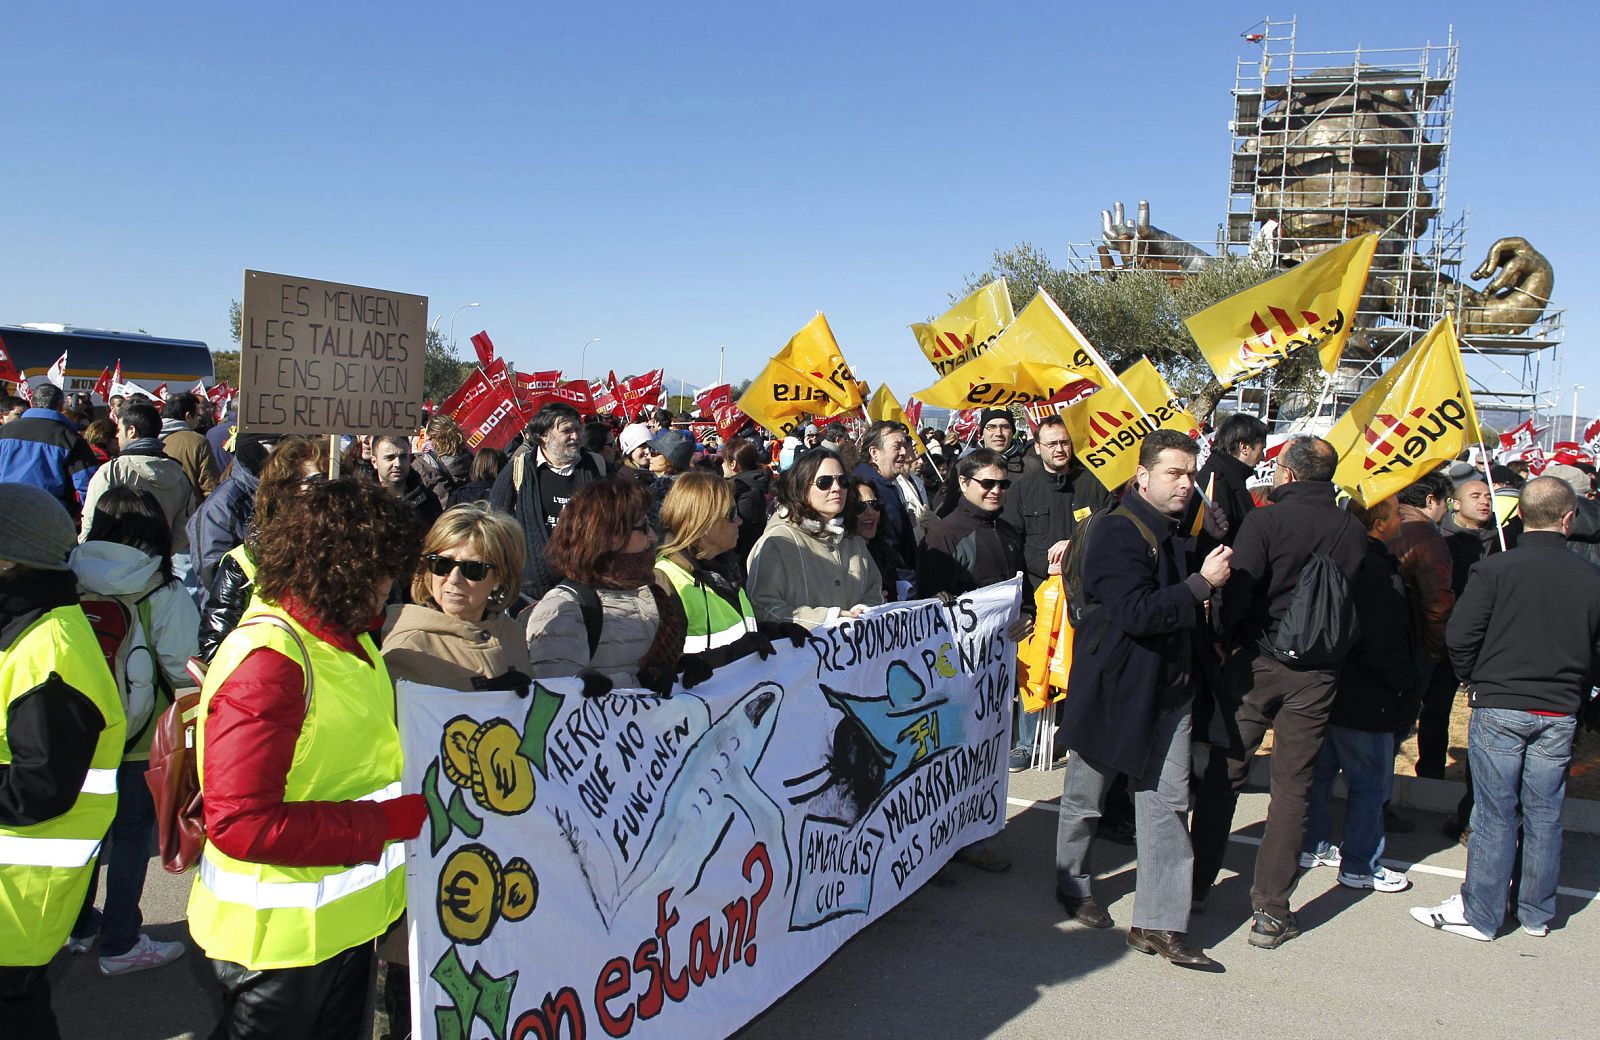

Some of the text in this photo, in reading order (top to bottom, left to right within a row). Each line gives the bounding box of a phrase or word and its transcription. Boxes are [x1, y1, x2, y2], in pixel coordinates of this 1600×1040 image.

[281, 284, 399, 327] ES MENGEN
[250, 317, 409, 362] LES TALLADES
[277, 357, 321, 391] ENS
[333, 361, 408, 395] DEIXEN
[245, 393, 417, 430] LES RETALLADES
[808, 598, 978, 680] RESPONSABILITATS
[578, 721, 644, 819] QUE NO
[882, 730, 1005, 844] MALBARATAMENT
[891, 833, 924, 891] DELS
[929, 806, 957, 856] FONS
[816, 880, 845, 914] CUP
[594, 841, 774, 1038] estan?
